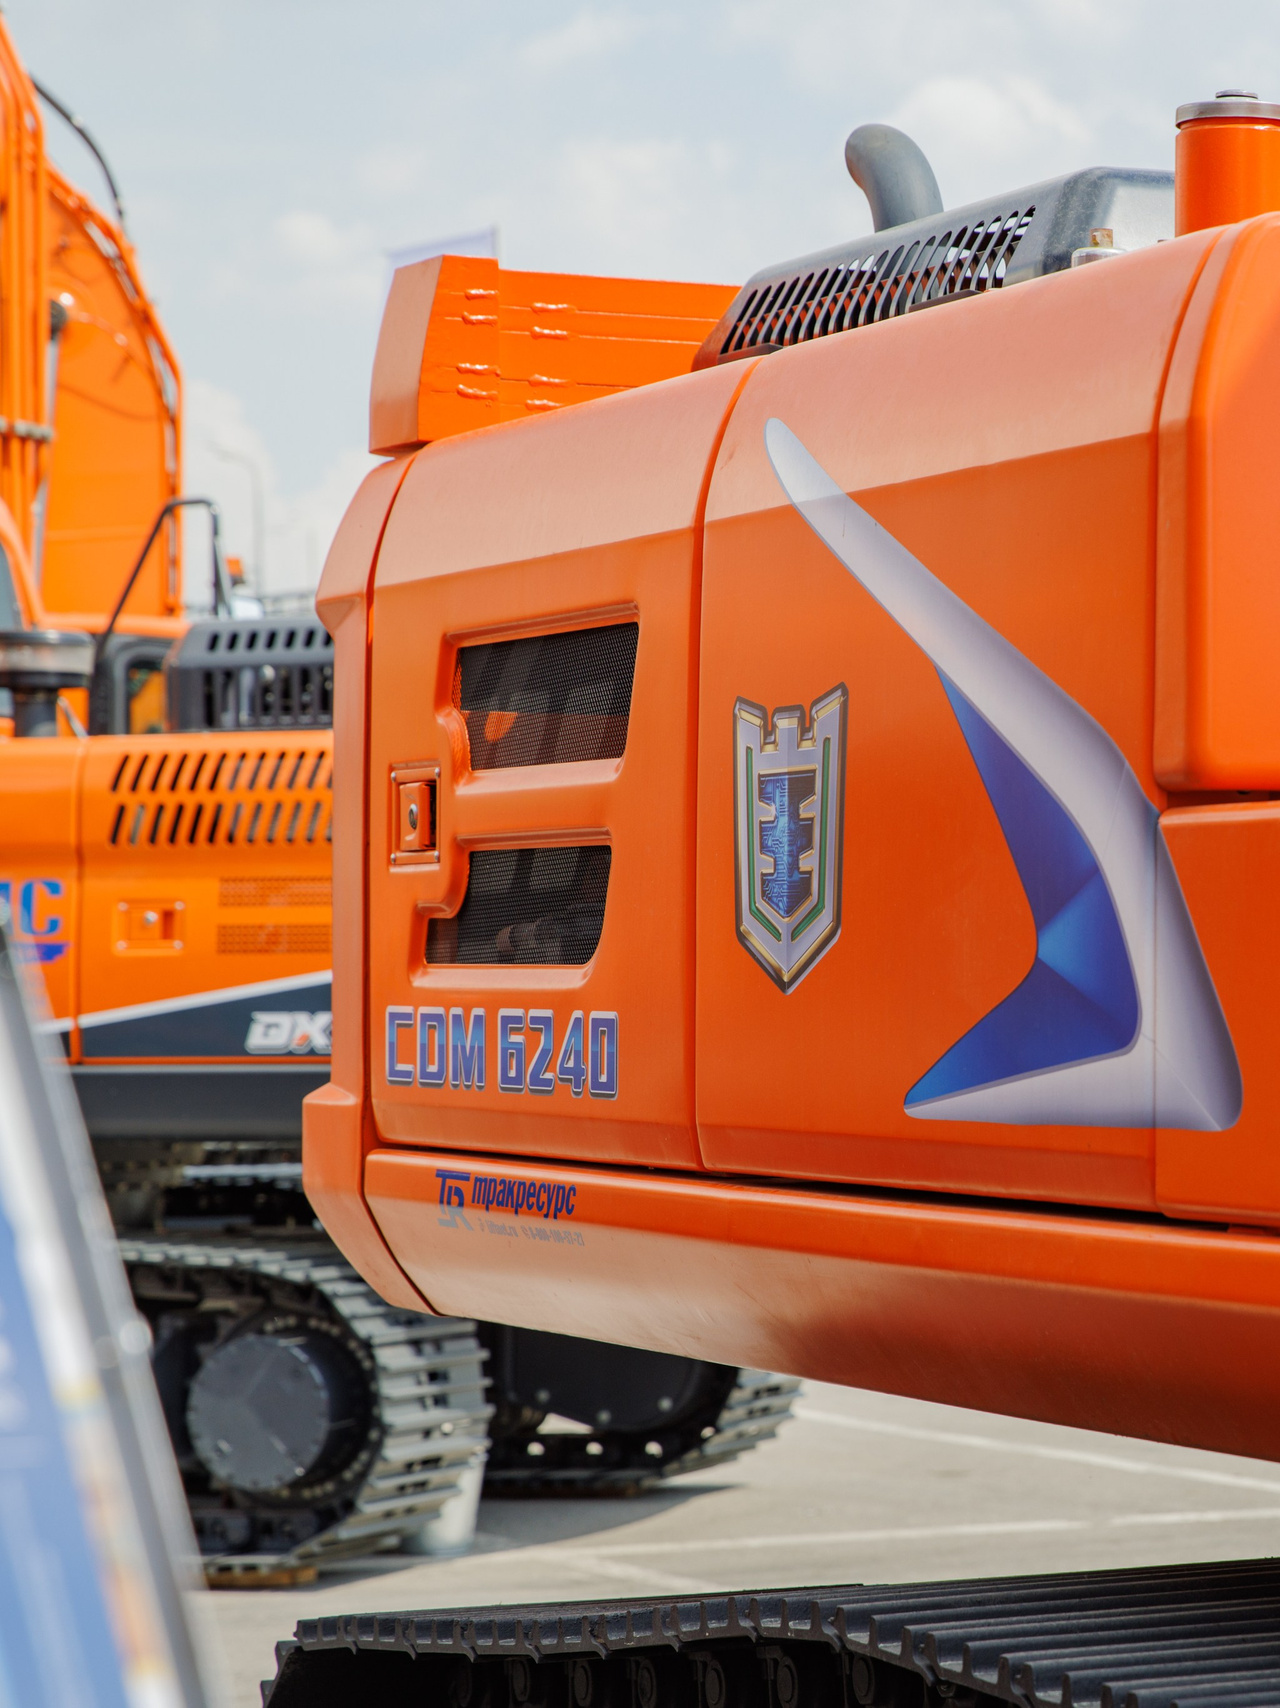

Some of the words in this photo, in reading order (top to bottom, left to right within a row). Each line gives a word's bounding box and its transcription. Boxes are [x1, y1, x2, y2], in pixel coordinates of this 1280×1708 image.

[386, 1006, 486, 1091] CDM
[498, 1008, 618, 1101] 6240
[471, 1175, 577, 1221] тракресурс
